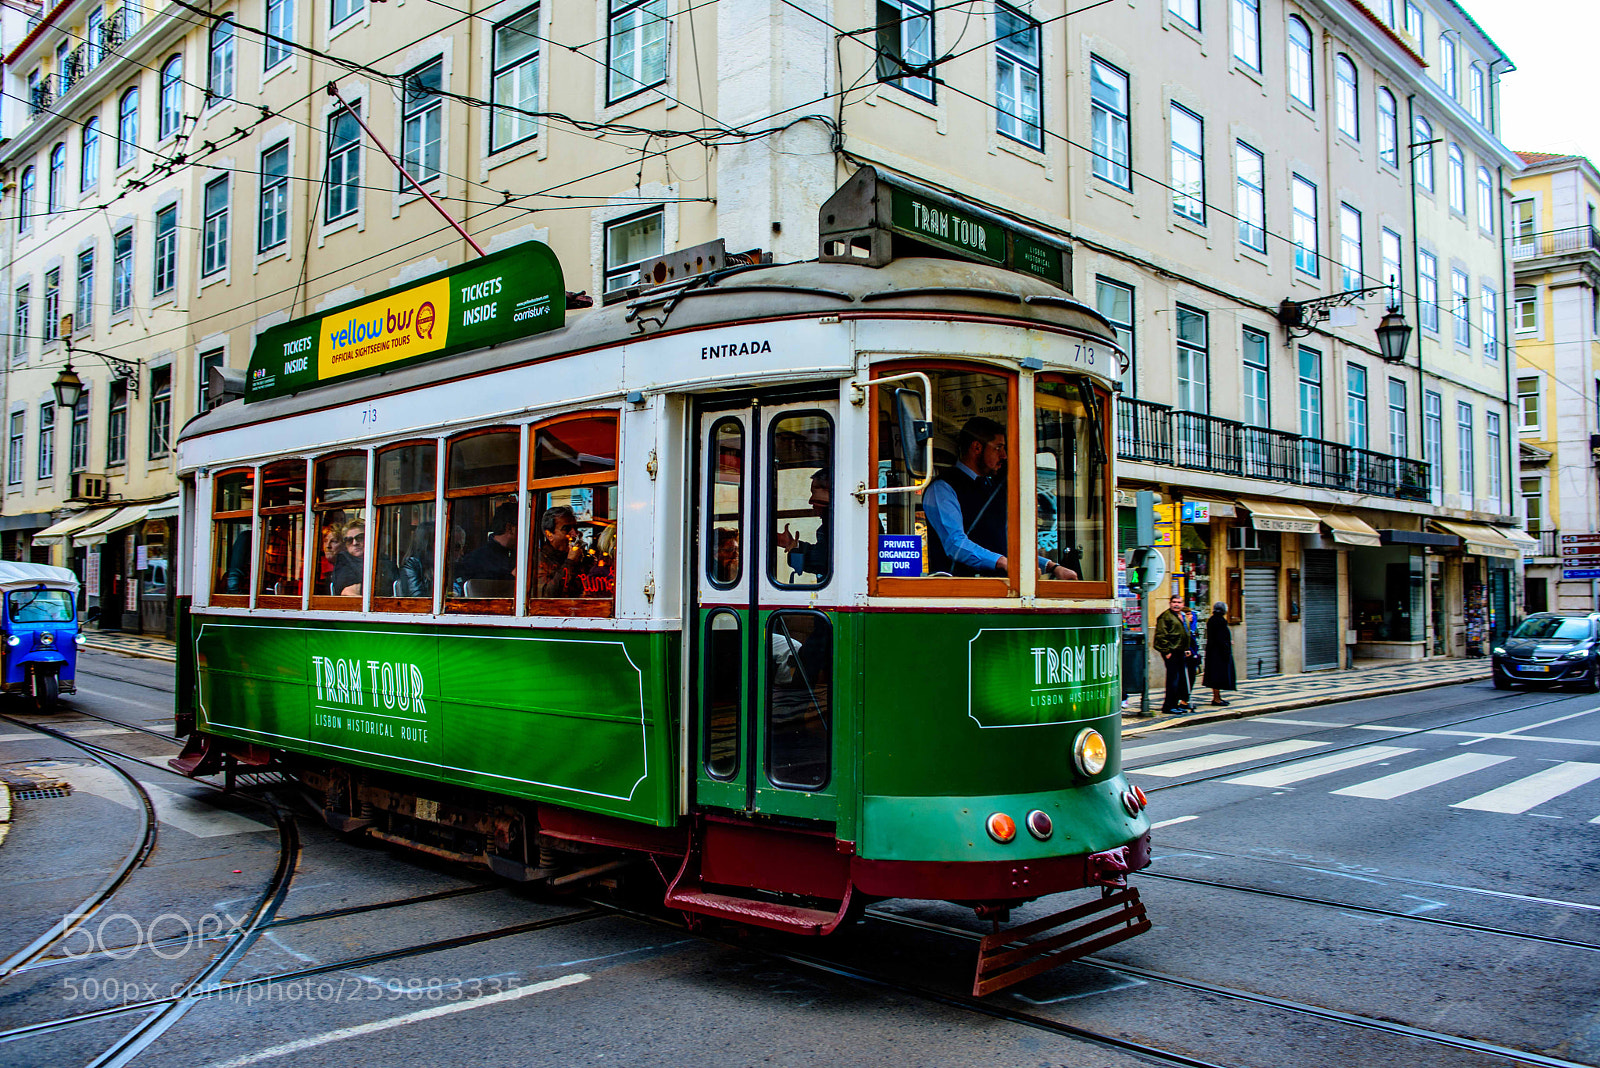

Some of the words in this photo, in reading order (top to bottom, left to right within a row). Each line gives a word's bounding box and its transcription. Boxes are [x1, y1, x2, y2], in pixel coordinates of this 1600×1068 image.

[912, 201, 949, 238] TRAM
[952, 215, 987, 252] TOUR
[1024, 253, 1050, 268] HISTORICAL
[1029, 246, 1046, 258] LISBON
[1031, 263, 1045, 275] ROUTE
[461, 276, 503, 303] TICKETS
[386, 307, 414, 334] bus
[463, 302, 498, 327] INSIDE
[283, 336, 312, 356] TICKETS
[331, 350, 354, 364] OFFICIAL
[355, 340, 390, 358] SIGHTSEEING
[391, 334, 411, 349] TOURS
[701, 340, 772, 360] ENTRADA
[1074, 344, 1095, 365] 713
[284, 356, 308, 375] INSIDE
[362, 408, 377, 425] 713
[878, 550, 920, 559] ORGANIZED
[883, 540, 915, 549] PRIVATE
[1030, 645, 1086, 685] TRAM
[312, 655, 364, 706] TRAM
[366, 660, 427, 715] TOUR
[1030, 694, 1064, 707] LISBON
[1069, 689, 1106, 703] HISTORICAL
[315, 713, 342, 729] LISBON
[347, 718, 395, 738] HISTORICAL
[401, 726, 429, 744] ROUTE
